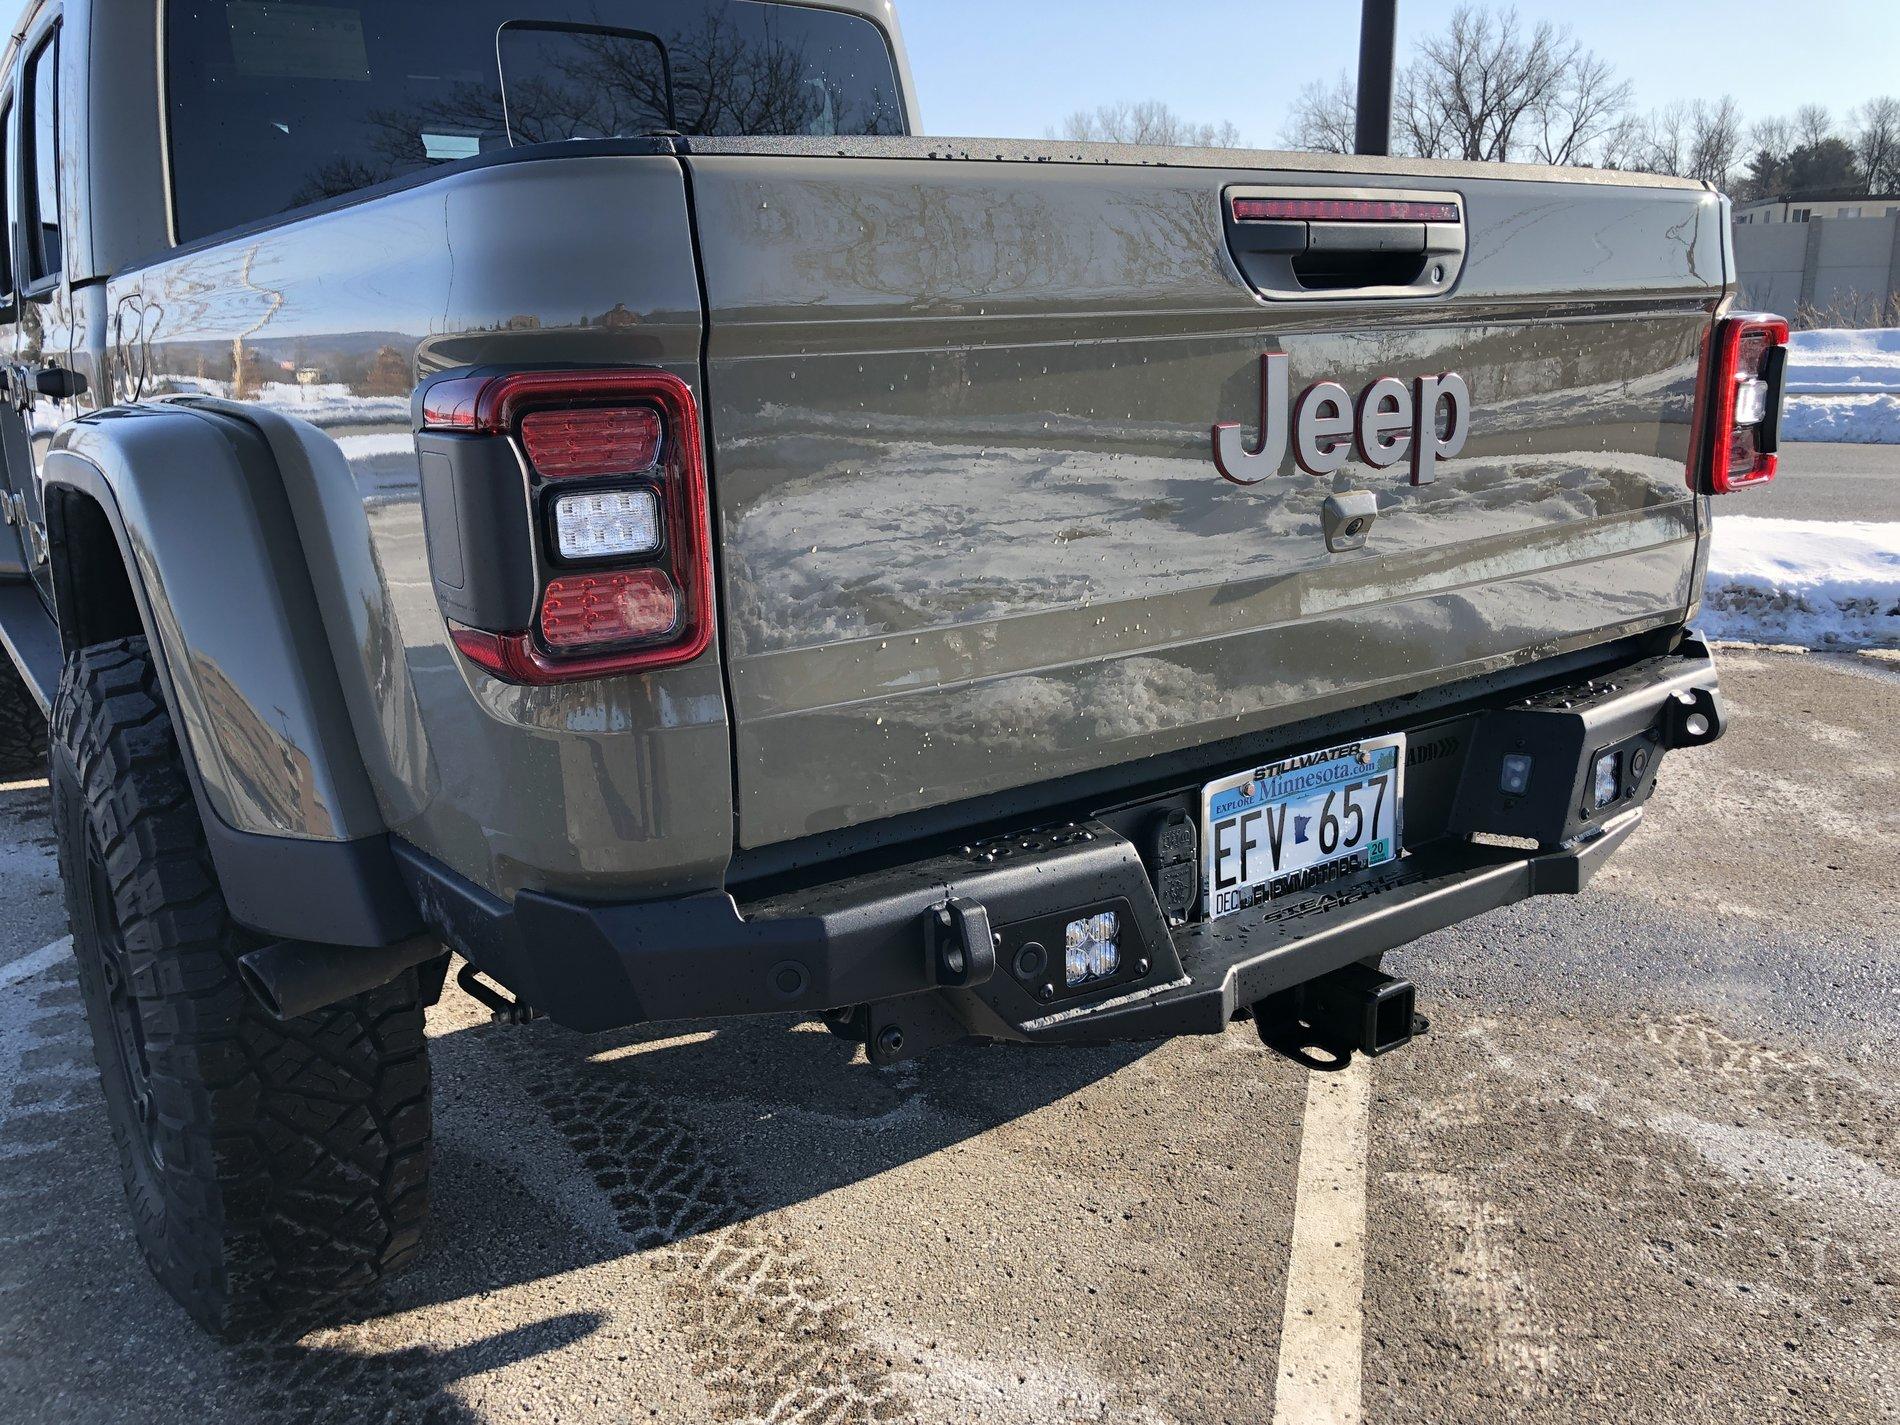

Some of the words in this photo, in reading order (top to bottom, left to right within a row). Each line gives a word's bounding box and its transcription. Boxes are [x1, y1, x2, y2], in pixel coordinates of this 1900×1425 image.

[1211, 351, 1470, 486] Jeep
[1253, 743, 1361, 782] STILLWATER
[1216, 797, 1254, 814] EXPLORE
[1259, 761, 1375, 802] Minnesota.com
[1214, 802, 1287, 891] EFV
[1318, 775, 1388, 855] 657
[1371, 841, 1384, 856] 20
[1216, 890, 1239, 915] DEC
